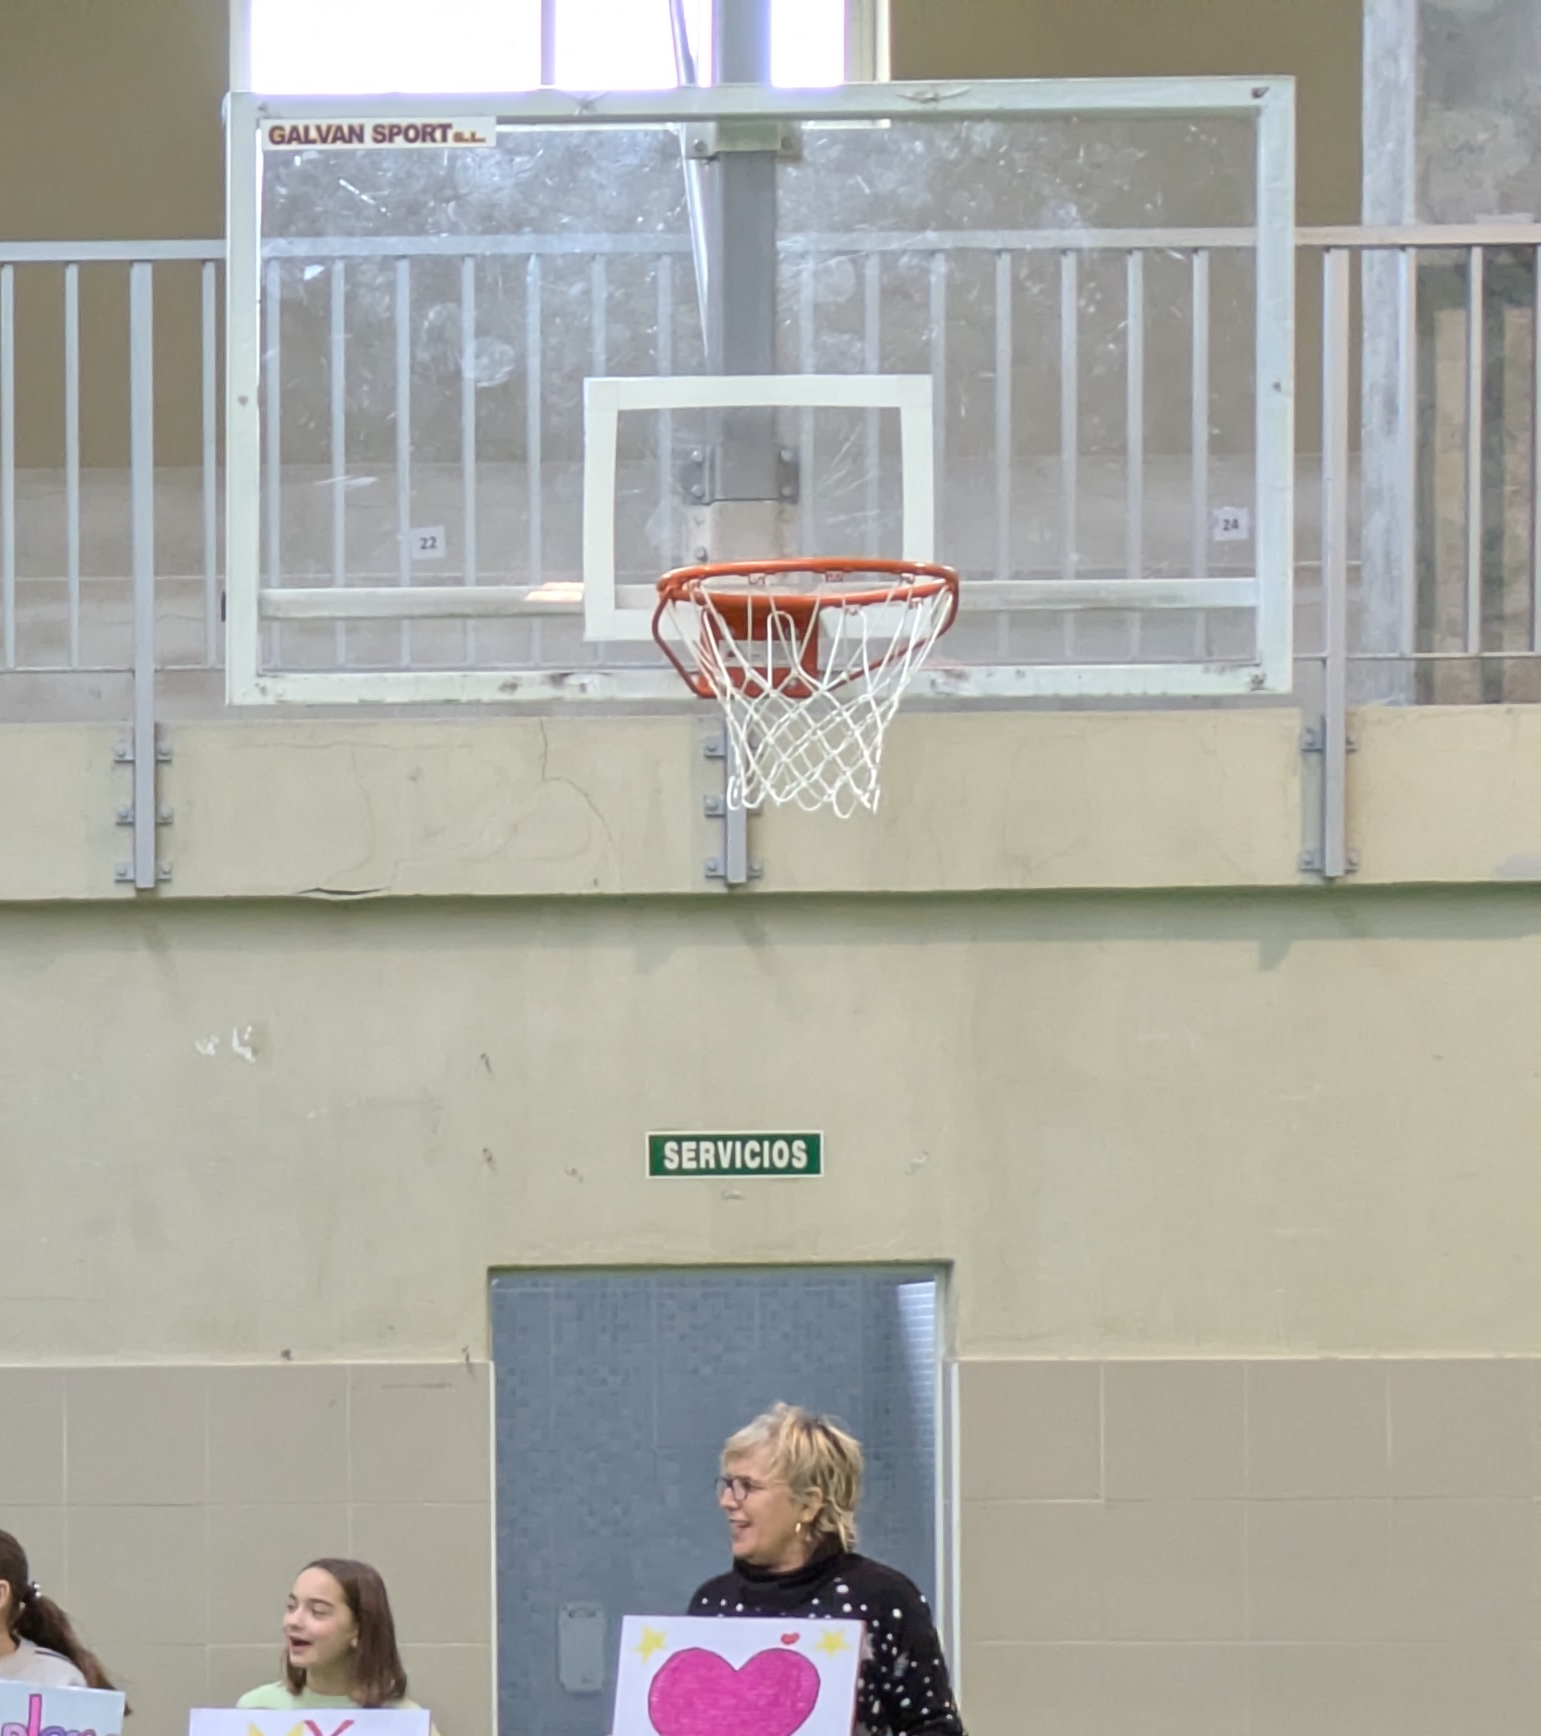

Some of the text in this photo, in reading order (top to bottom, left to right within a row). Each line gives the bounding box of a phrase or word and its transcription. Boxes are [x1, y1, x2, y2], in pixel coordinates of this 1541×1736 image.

[268, 124, 365, 145] GALVAN
[372, 123, 453, 144] SPORT
[420, 536, 437, 549] 22
[663, 1139, 808, 1169] SERVICIOS
